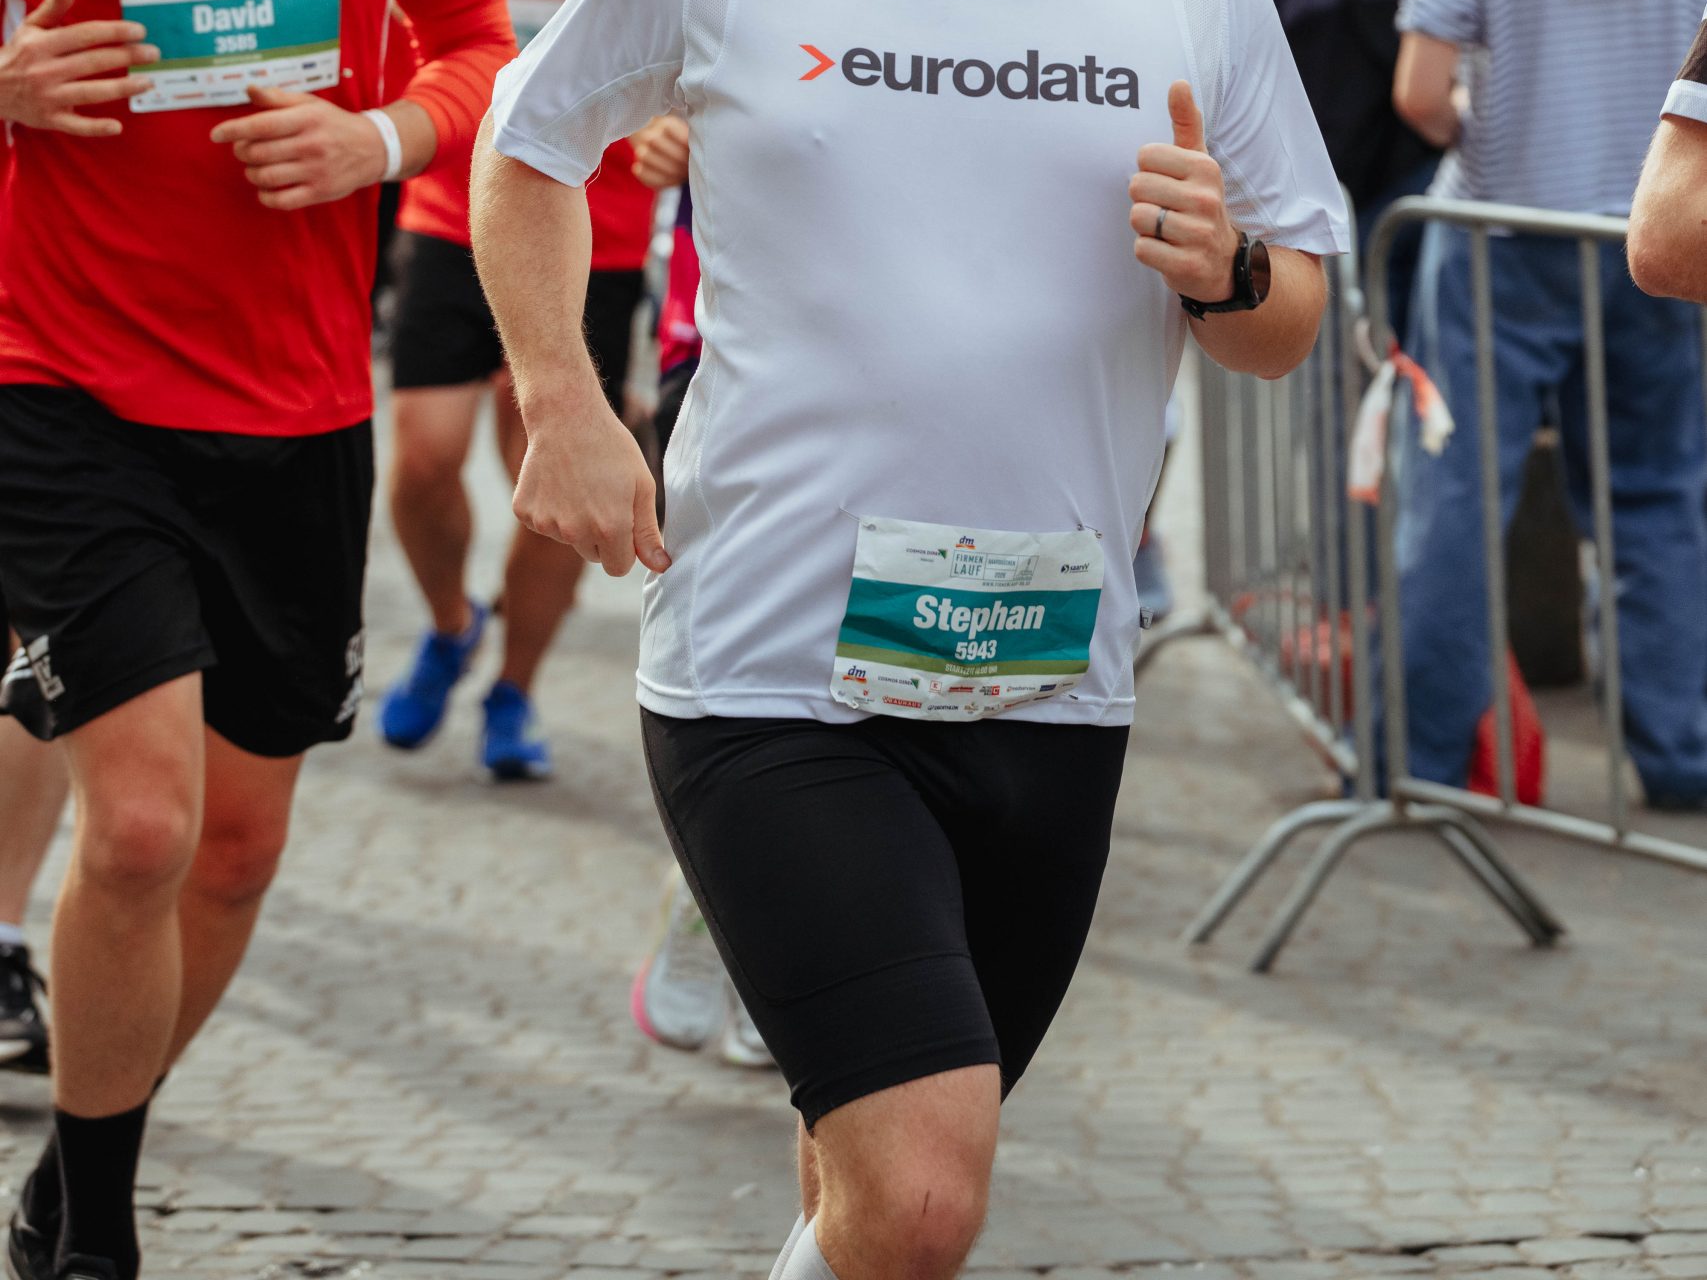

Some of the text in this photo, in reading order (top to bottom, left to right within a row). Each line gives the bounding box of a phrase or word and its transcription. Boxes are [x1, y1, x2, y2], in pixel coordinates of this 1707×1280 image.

[841, 47, 1140, 109] eurodata
[958, 535, 975, 546] dm
[956, 553, 984, 564] FIRMEN
[953, 563, 982, 577] LAUF
[913, 594, 1045, 640] Stephan
[955, 640, 997, 660] 5943
[847, 665, 867, 678] dm
